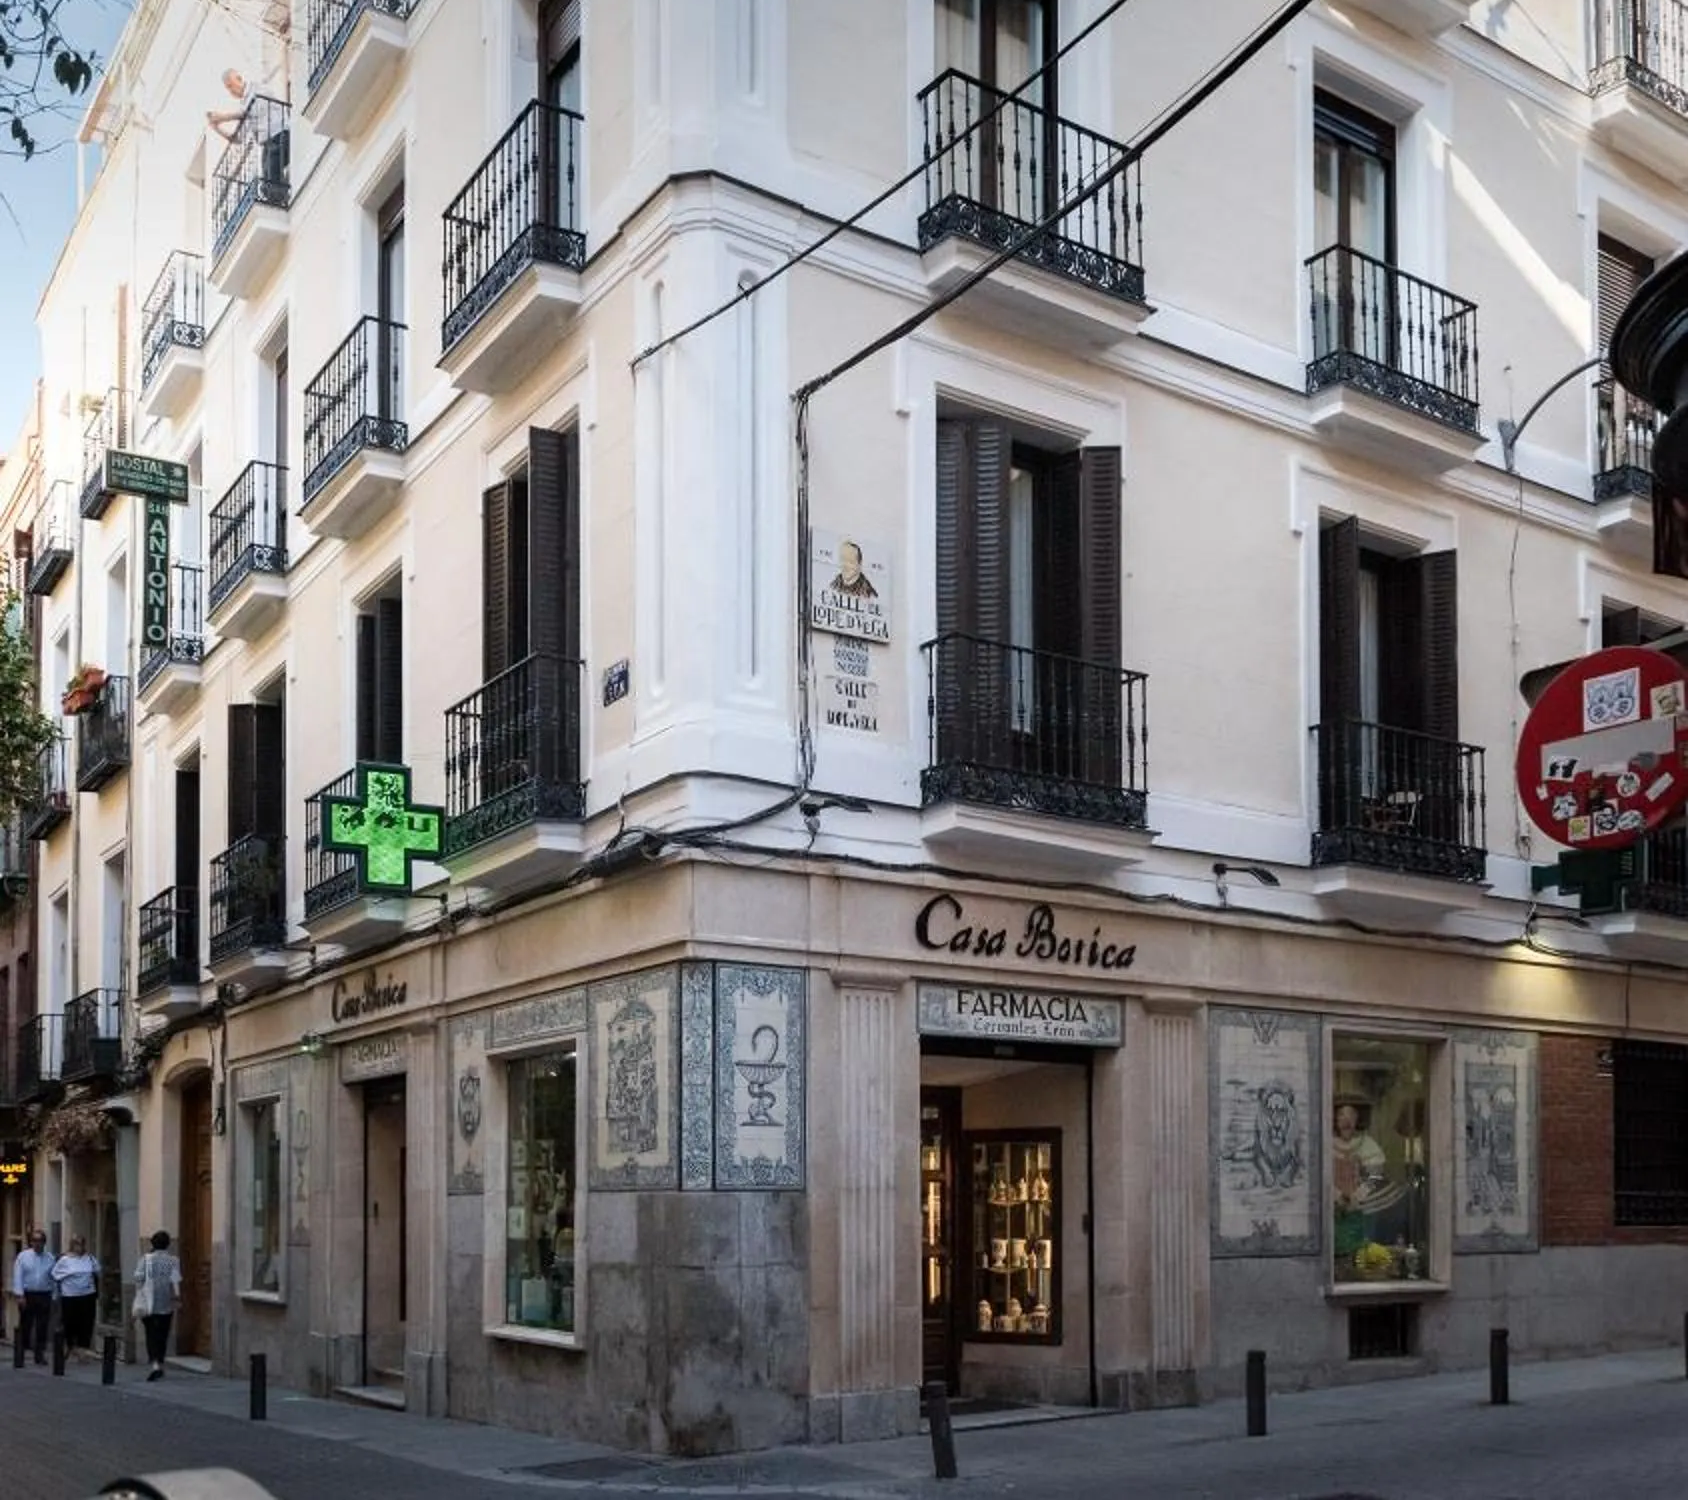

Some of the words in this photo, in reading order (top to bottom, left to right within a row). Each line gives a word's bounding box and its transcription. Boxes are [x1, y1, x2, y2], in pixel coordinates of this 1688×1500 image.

[112, 453, 166, 477] HOSTAL
[148, 518, 167, 642] ANTONIO
[813, 605, 845, 629] LOPE
[821, 589, 864, 612] CALLE
[915, 894, 1006, 956] Casa
[332, 978, 361, 1023] Casa
[957, 989, 1088, 1023] FARMACIA
